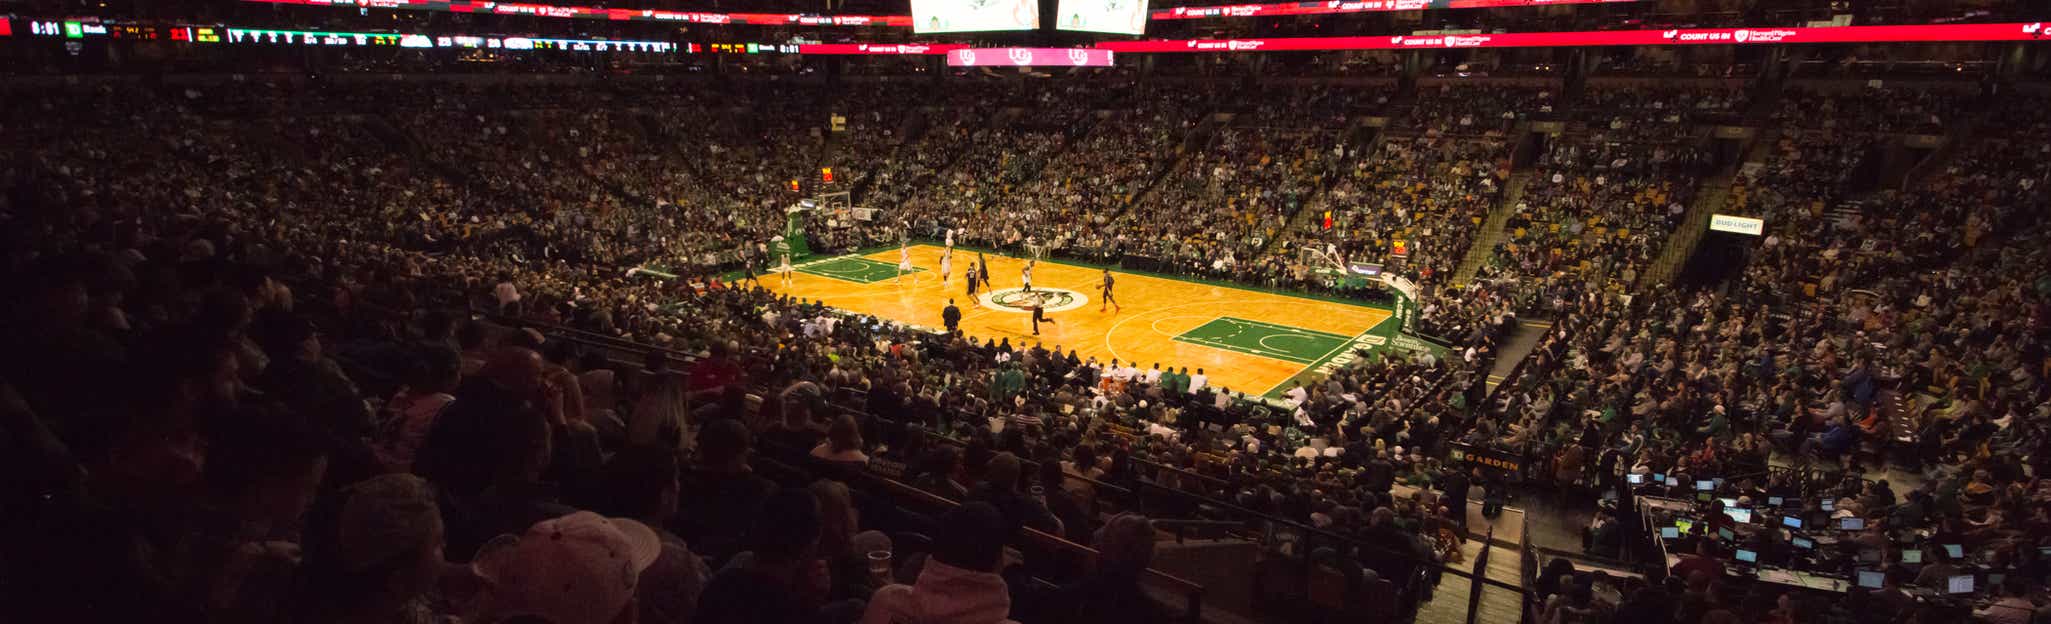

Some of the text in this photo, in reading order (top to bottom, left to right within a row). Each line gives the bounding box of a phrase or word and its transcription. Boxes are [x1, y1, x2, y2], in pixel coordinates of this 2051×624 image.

[1680, 31, 1731, 41] COUNT US IN
[1716, 219, 1758, 230] BUD LIGHT
[1465, 453, 1519, 472] GARDEN
